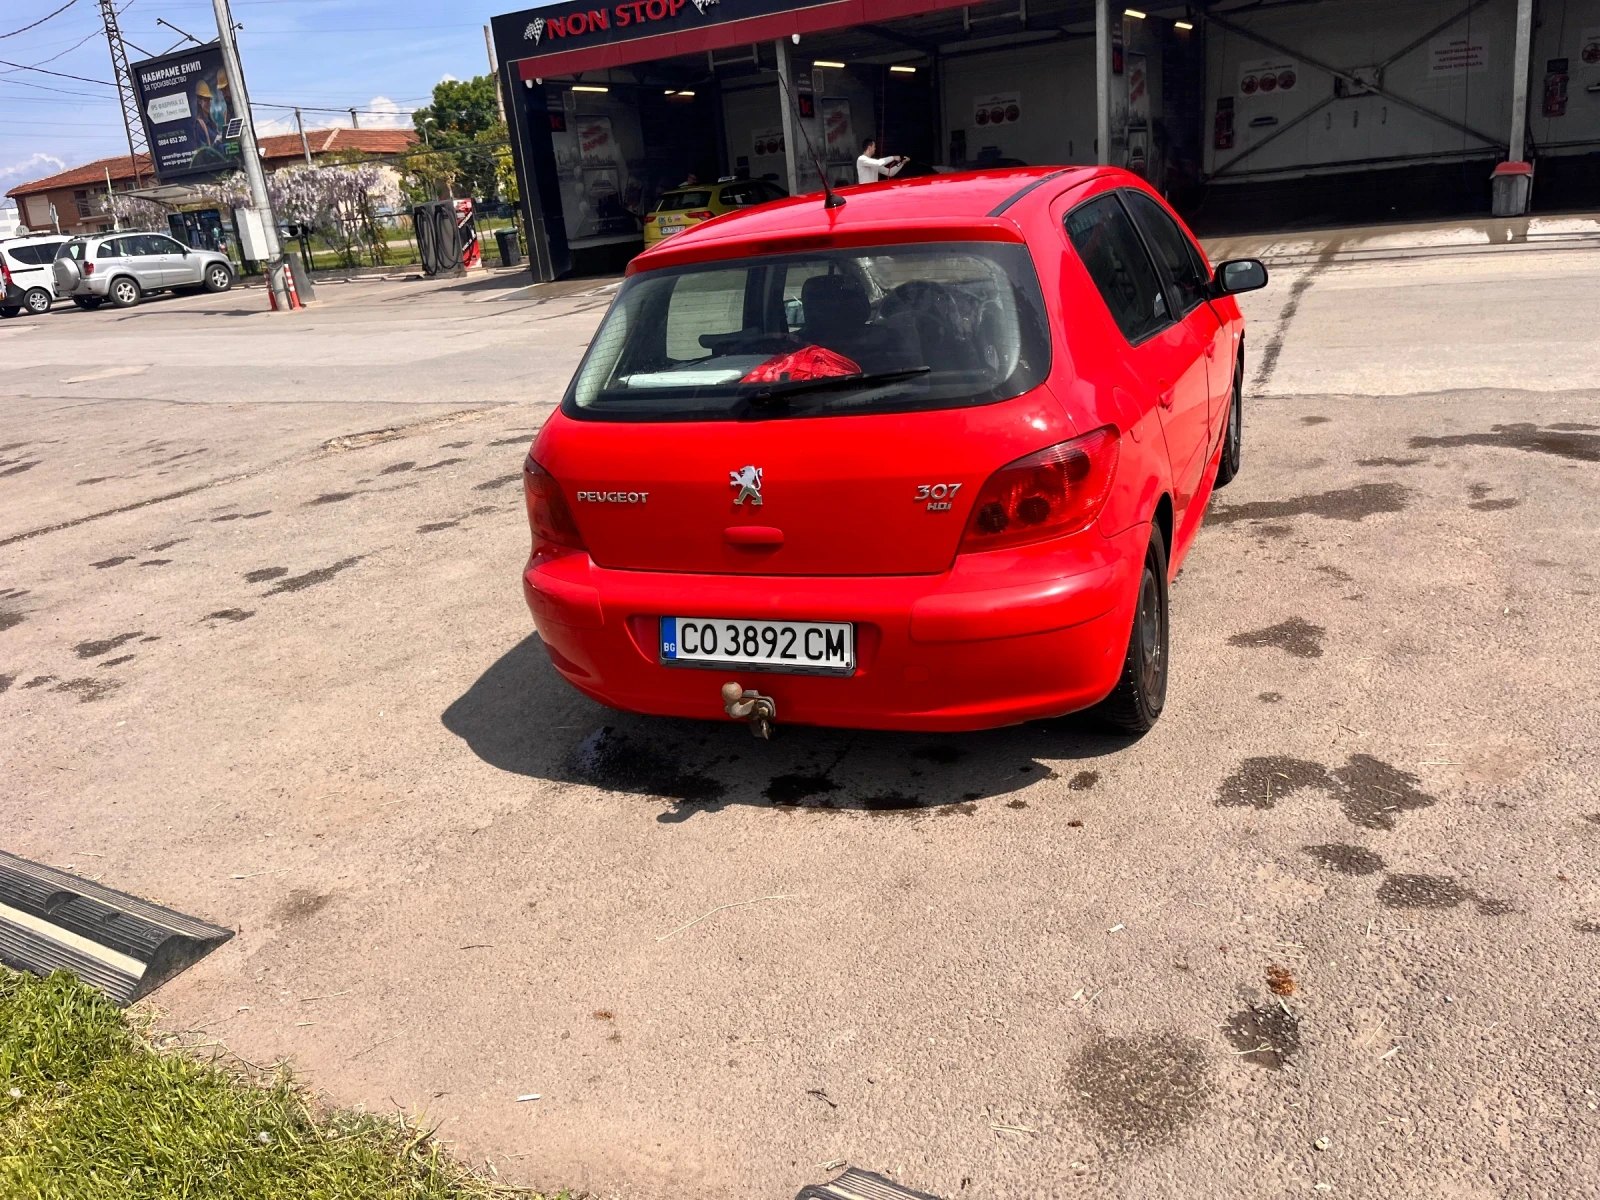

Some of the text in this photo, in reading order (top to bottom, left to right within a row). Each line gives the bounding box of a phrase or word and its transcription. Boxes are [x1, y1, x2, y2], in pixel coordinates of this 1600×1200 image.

[547, 0, 686, 39] NON STOP
[141, 61, 202, 84] НАБИРАМЕ ЕКИП
[144, 76, 187, 92] за производство
[577, 491, 649, 503] PEUGEOT
[914, 482, 962, 500] 307
[663, 642, 676, 652] BG
[681, 623, 845, 662] CO 3892 CM
